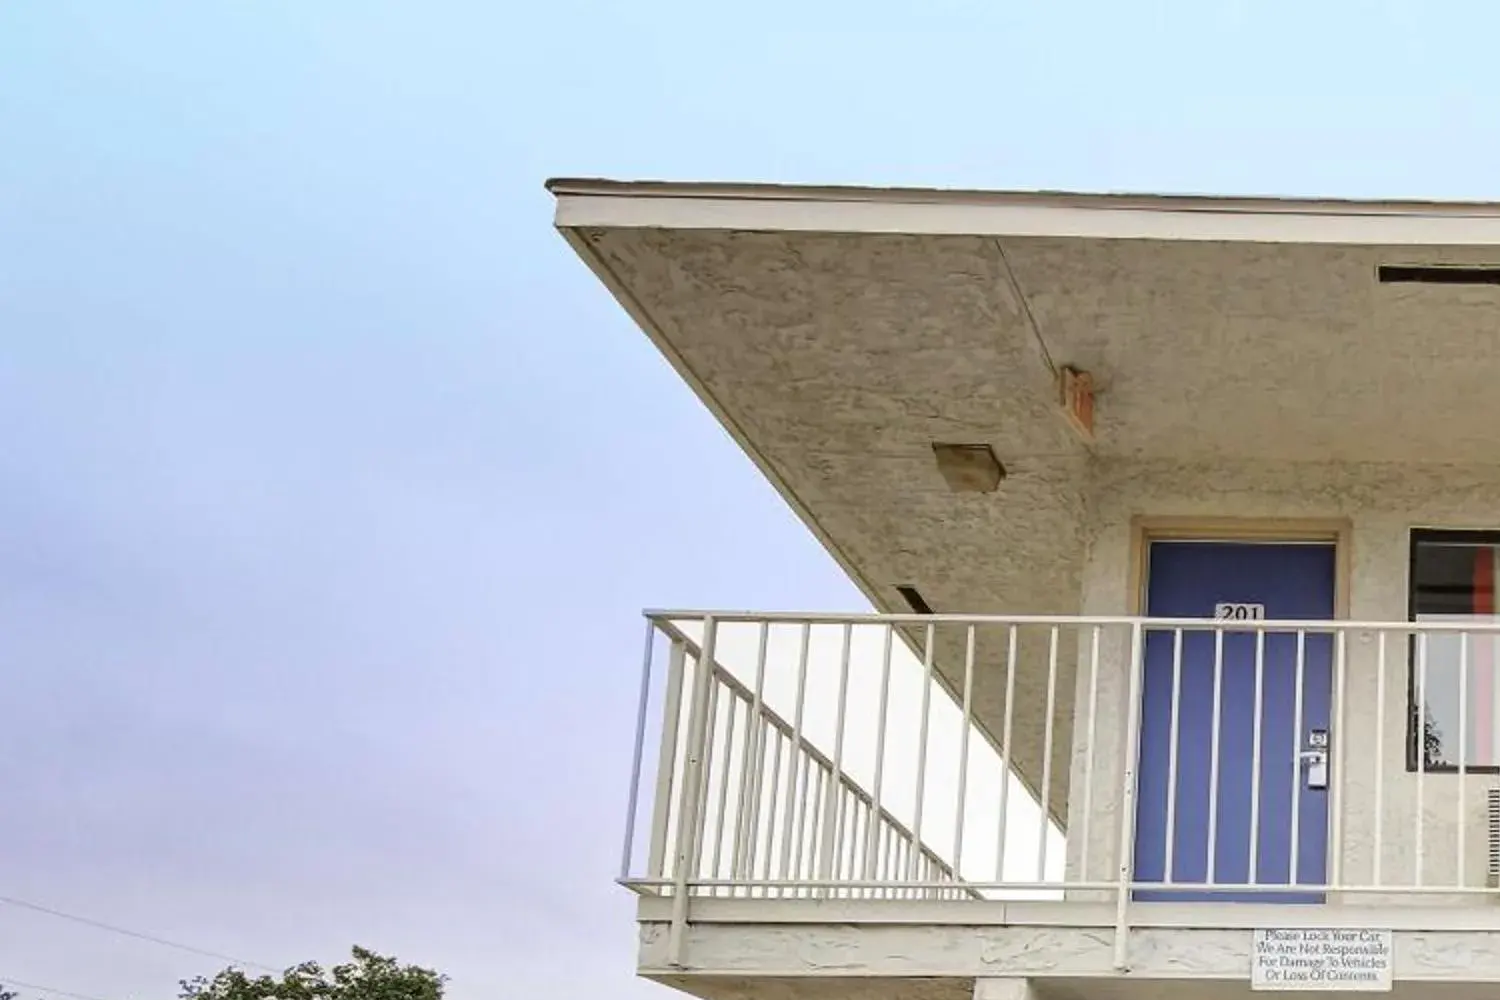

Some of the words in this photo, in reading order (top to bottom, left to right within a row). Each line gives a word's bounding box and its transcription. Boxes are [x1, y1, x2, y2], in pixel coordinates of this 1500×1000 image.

[1222, 605, 1258, 620] 201
[1265, 930, 1299, 941] Please
[1303, 930, 1329, 941] Lock
[1332, 930, 1358, 941] Your
[1257, 942, 1275, 953] We
[1277, 943, 1297, 953] Are
[1299, 943, 1319, 953] Not
[1323, 943, 1388, 956] Responsible
[1259, 955, 1278, 967] For
[1279, 956, 1324, 969] Damage
[1326, 956, 1339, 967] To
[1341, 957, 1387, 968] Vehicles
[1265, 969, 1280, 980] Or
[1310, 969, 1325, 980] Of
